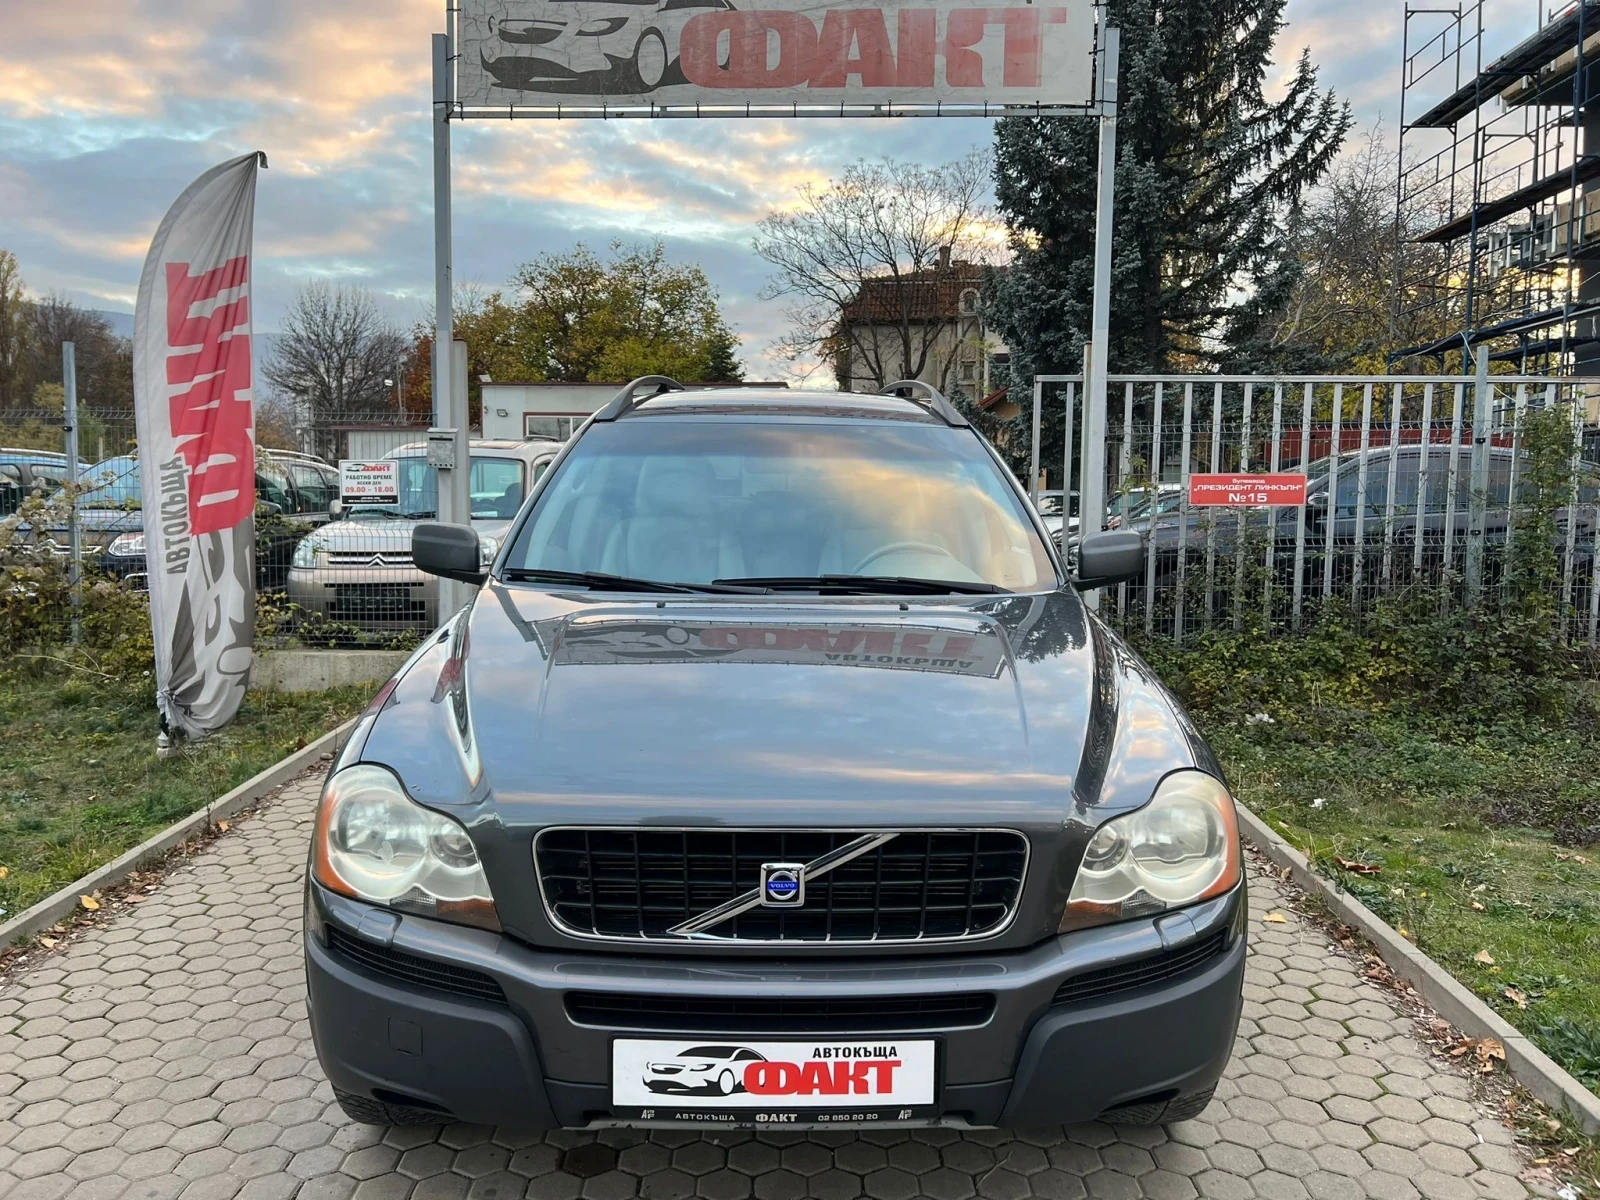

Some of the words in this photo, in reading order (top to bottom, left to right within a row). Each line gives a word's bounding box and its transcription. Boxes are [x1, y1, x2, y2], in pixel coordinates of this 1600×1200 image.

[680, 7, 1067, 88] ФАКТ
[165, 254, 255, 535] ФАКТ
[160, 456, 190, 575] АВТОКЪЩА
[743, 1060, 902, 1095] ФАКТ
[812, 1046, 898, 1059] АВТОКЪЩА
[755, 1112, 798, 1122] ФАКТ
